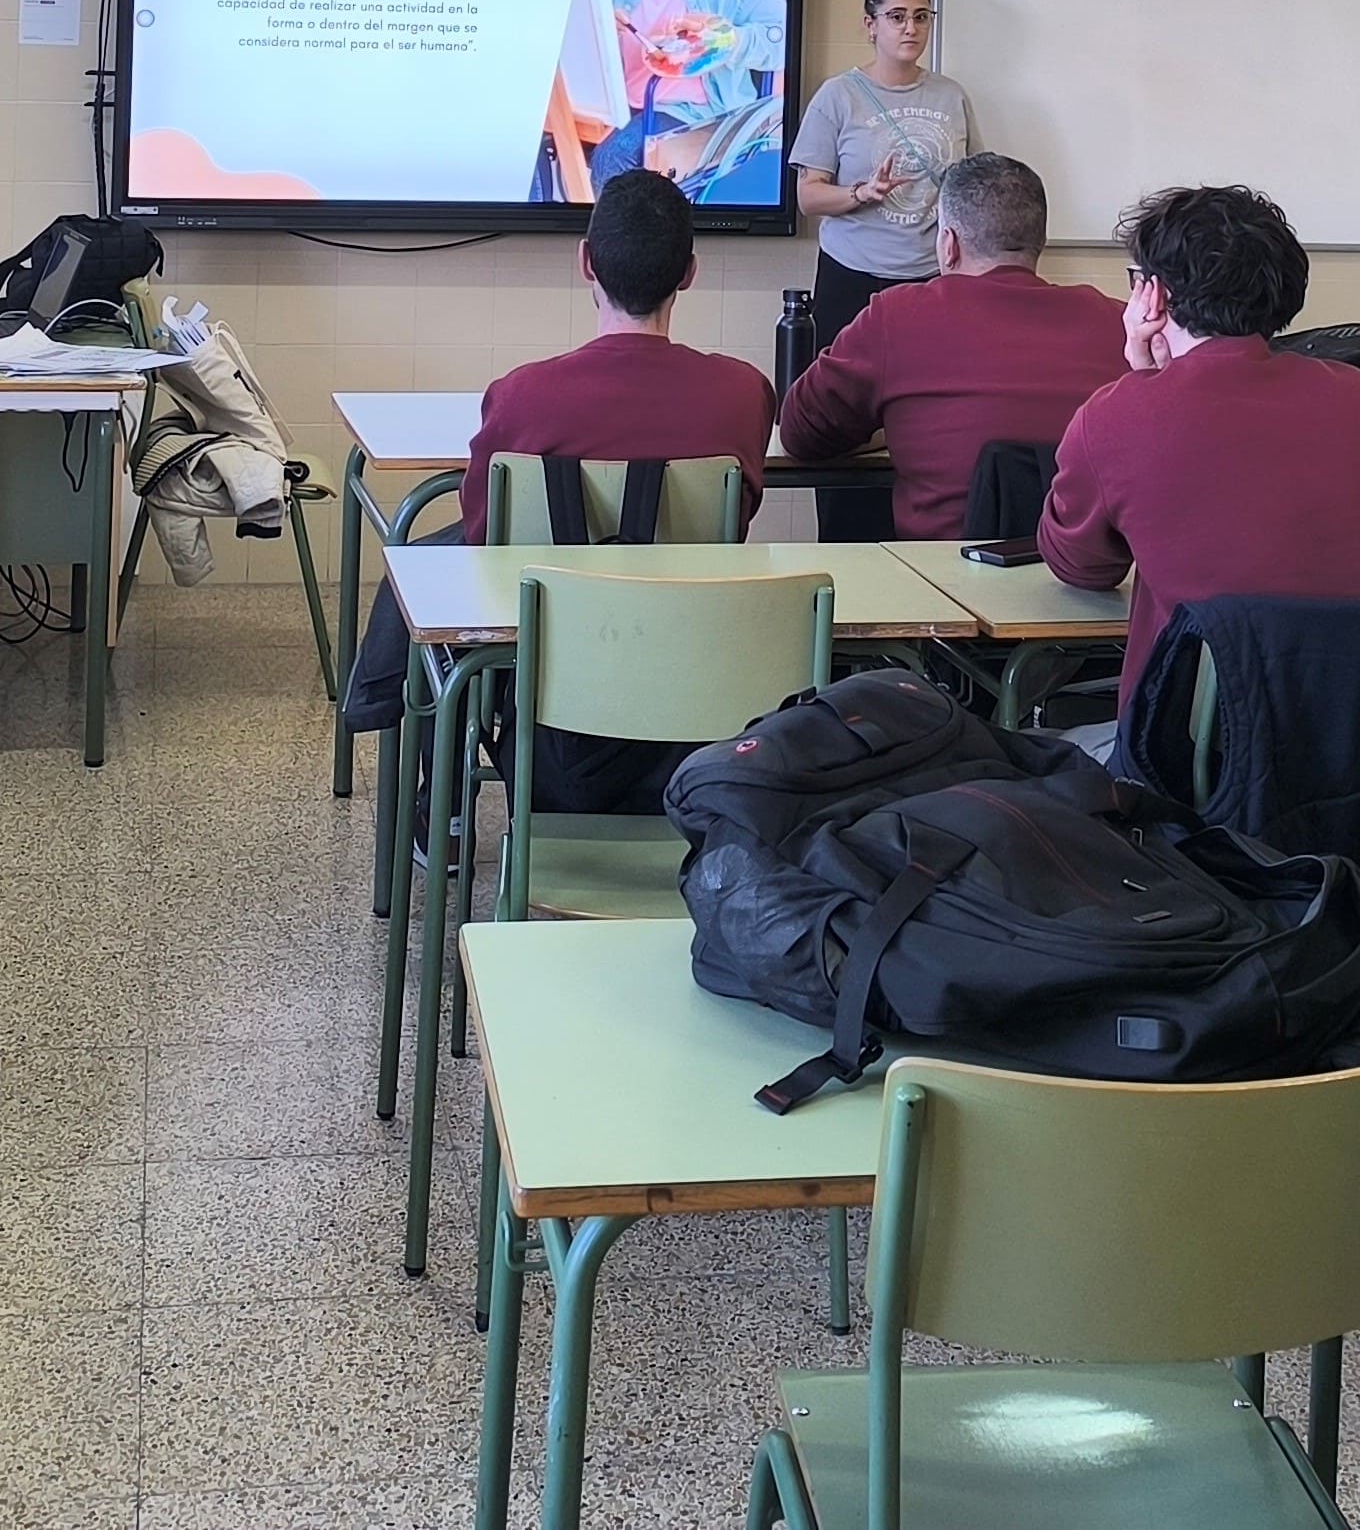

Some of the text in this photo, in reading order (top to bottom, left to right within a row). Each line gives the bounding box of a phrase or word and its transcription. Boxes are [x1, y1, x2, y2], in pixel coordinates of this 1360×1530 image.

[309, 0, 357, 12] realizar
[360, 3, 383, 13] una
[387, 1, 444, 14] actividad
[448, 5, 464, 15] en
[467, 3, 479, 15] la
[266, 16, 478, 35] forma o dentro del margen que se
[238, 36, 301, 48] considera
[304, 37, 347, 49] normal
[350, 40, 379, 52] para
[383, 38, 394, 50] el
[398, 40, 417, 51] ser
[903, 107, 950, 123] ENERGY
